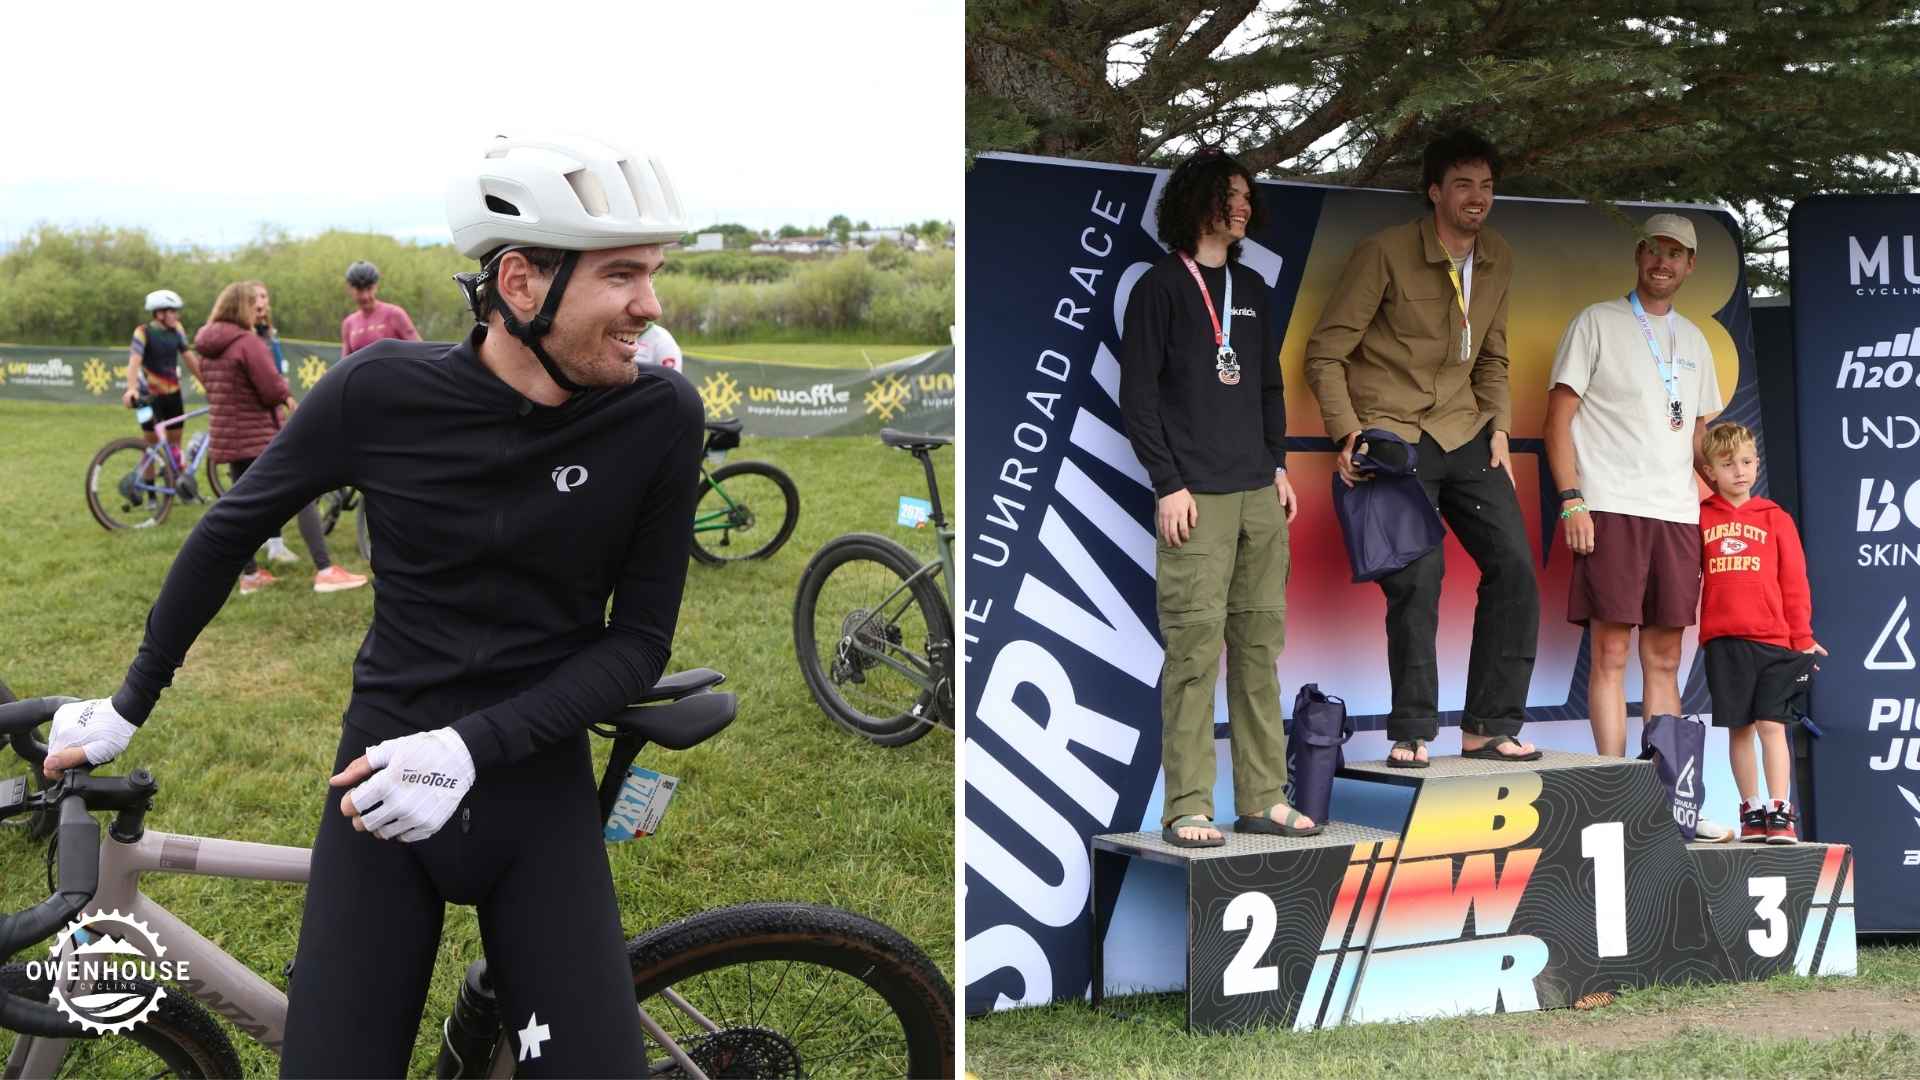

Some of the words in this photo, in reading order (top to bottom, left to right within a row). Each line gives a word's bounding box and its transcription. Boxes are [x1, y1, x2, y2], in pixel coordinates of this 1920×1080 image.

[1054, 190, 1126, 330] RACE
[750, 383, 849, 407] unwaffle
[1703, 521, 1743, 545] KANSAS
[1743, 524, 1768, 545] CITY
[1709, 555, 1761, 574] CHIEFS
[1868, 698, 1920, 731] PI
[1581, 821, 1628, 958] 1
[1747, 876, 1789, 958] 3
[1222, 891, 1279, 997] 2
